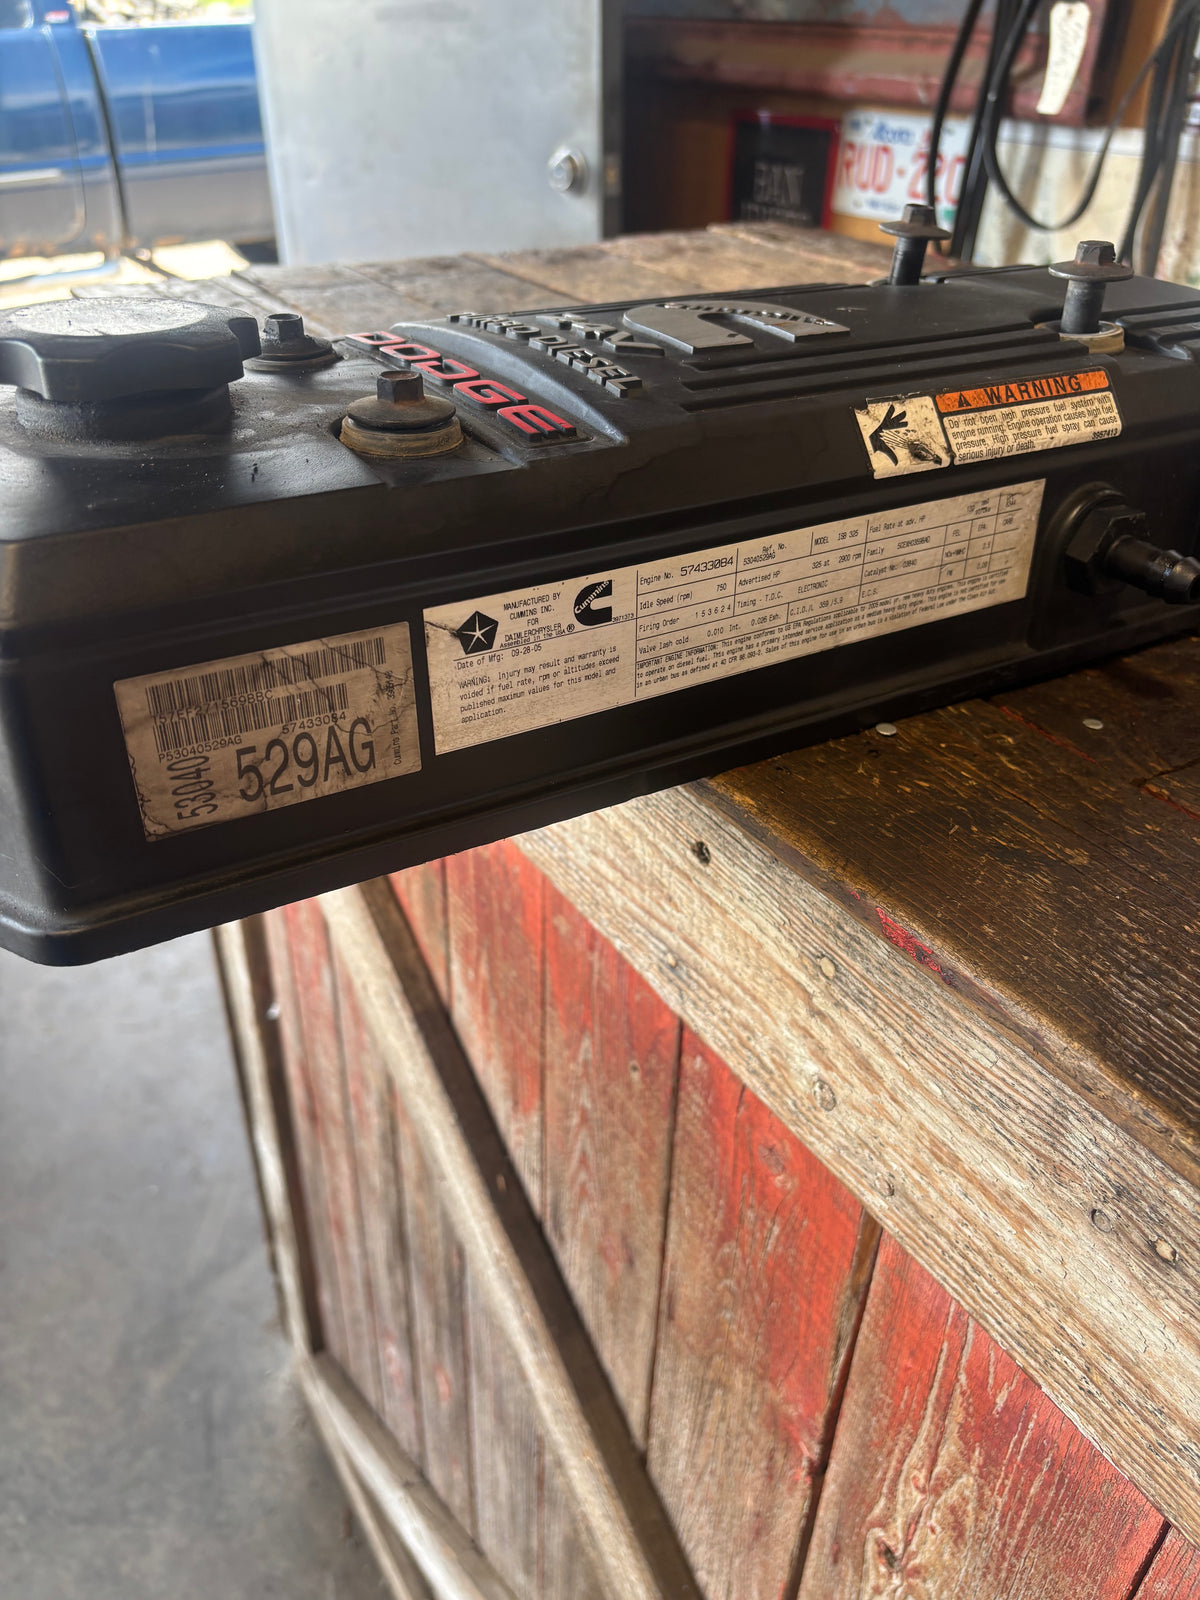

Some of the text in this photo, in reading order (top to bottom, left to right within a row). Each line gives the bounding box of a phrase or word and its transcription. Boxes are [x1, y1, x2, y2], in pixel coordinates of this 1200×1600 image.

[529, 333, 642, 398] DIESEL
[345, 330, 577, 442] DODGE
[983, 375, 1081, 405] WARNING
[947, 392, 1111, 429] Do not open high pressure fuel system with
[951, 428, 976, 442] engine
[1006, 418, 1030, 432] Engine
[1030, 412, 1062, 428] operation
[1062, 409, 1086, 421] causes
[1086, 406, 1101, 418] high
[1101, 403, 1114, 414] fuel
[992, 433, 1009, 445] High
[1012, 427, 1042, 441] pressure
[1044, 423, 1058, 434] fuel
[1061, 421, 1080, 433] spray
[1082, 418, 1095, 428] can
[1098, 414, 1117, 425] cause
[957, 439, 1035, 462] serious injury or death.
[869, 523, 880, 533] Fuel
[883, 520, 895, 530] Rate
[897, 519, 903, 527] at
[761, 541, 787, 553] Ref. No.
[814, 535, 829, 546] MODEL
[866, 545, 884, 557] Family
[811, 551, 862, 569] 325 at 2900 rpm
[863, 565, 887, 579] Catalyst
[640, 573, 660, 586] Engine
[663, 571, 673, 580] No.
[738, 570, 780, 587] Advertised HP
[503, 594, 550, 610] MANUFACTURED
[574, 579, 610, 615] Cummins
[639, 582, 726, 609] Idle Speed (rpm) 750
[737, 597, 756, 609] Timing
[797, 579, 828, 593] ELECTRONIC
[509, 604, 554, 620] CUMMINS INC.
[527, 617, 538, 626] FOR
[639, 616, 679, 633] Firing Order
[499, 636, 531, 648] Assembled
[504, 622, 561, 642] DAIMLERCHRYSLER
[639, 643, 656, 654] Valve
[659, 639, 672, 649] lash
[675, 635, 688, 645] cold
[707, 626, 723, 637] 0.010
[457, 643, 542, 670] Date of Mfg: 09-28-05
[459, 645, 616, 689] WARNING: Injury may result and warranty is
[460, 688, 483, 700] voided
[486, 685, 495, 694] if
[498, 681, 512, 691] fuel
[516, 676, 534, 687] rate,
[539, 673, 550, 682] rpm
[563, 661, 595, 675] altitudes
[598, 655, 619, 666] exceed
[460, 667, 616, 713] published maximum values for this model and
[280, 710, 346, 735] 57433084
[461, 706, 506, 724] application.
[157, 734, 243, 764] P53040529AG
[231, 715, 377, 805] 529AG
[165, 752, 219, 822] 53040
